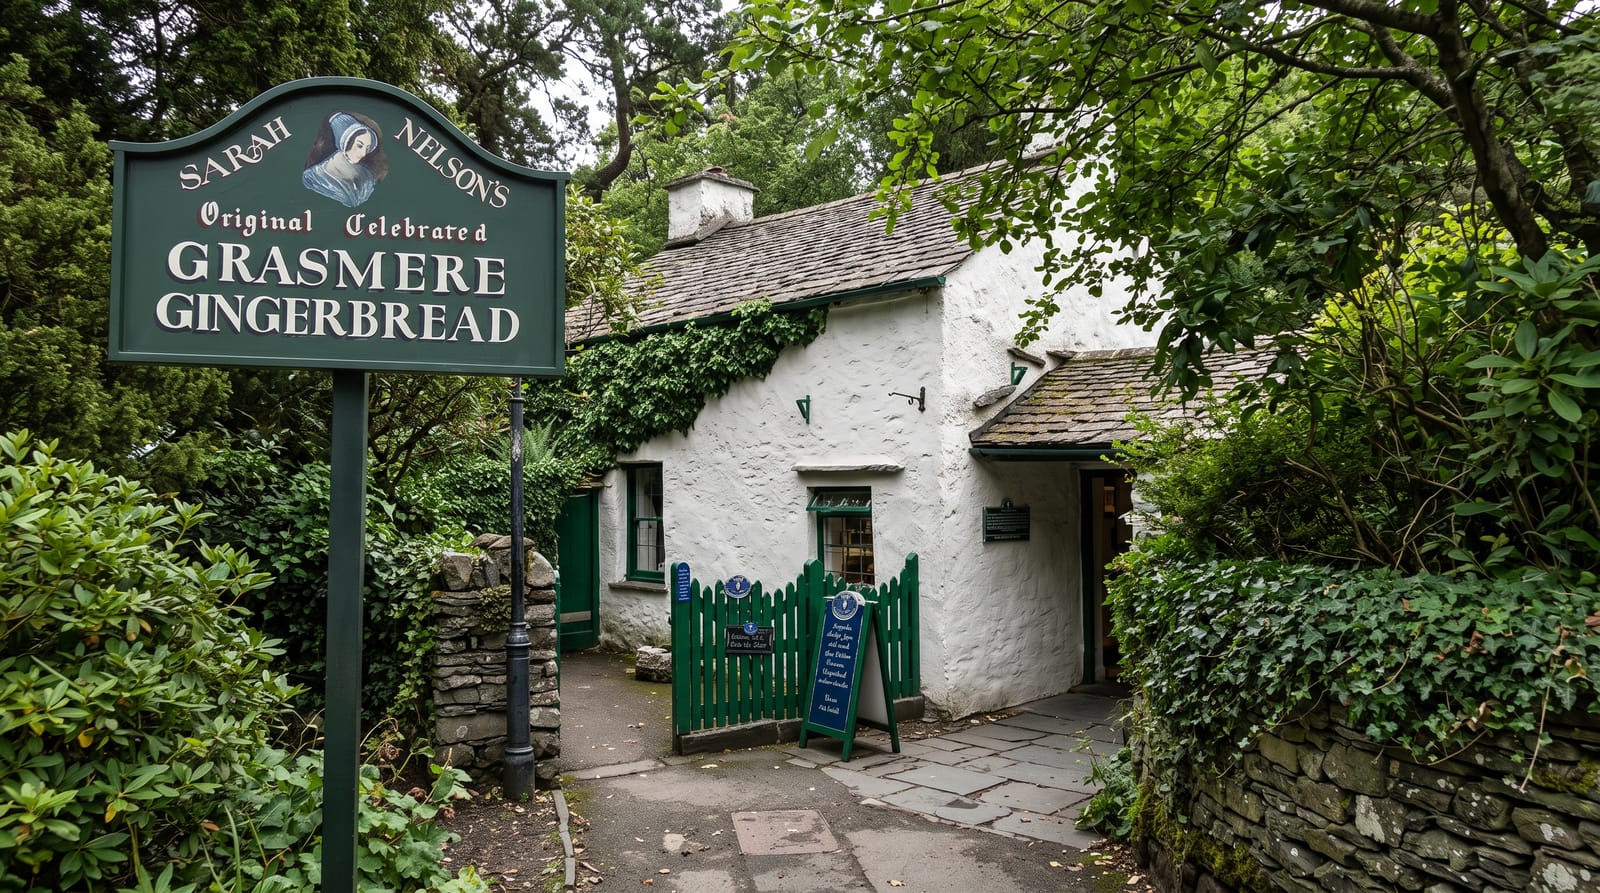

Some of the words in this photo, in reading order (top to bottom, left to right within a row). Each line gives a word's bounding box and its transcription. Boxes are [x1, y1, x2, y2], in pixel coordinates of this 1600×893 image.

[179, 116, 292, 190] SARAH
[394, 117, 510, 209] NELSON'S
[200, 201, 313, 237] Original
[345, 213, 488, 243] Celebrated
[167, 240, 506, 296] GRASMERE
[156, 292, 520, 343] GINGERBREAD
